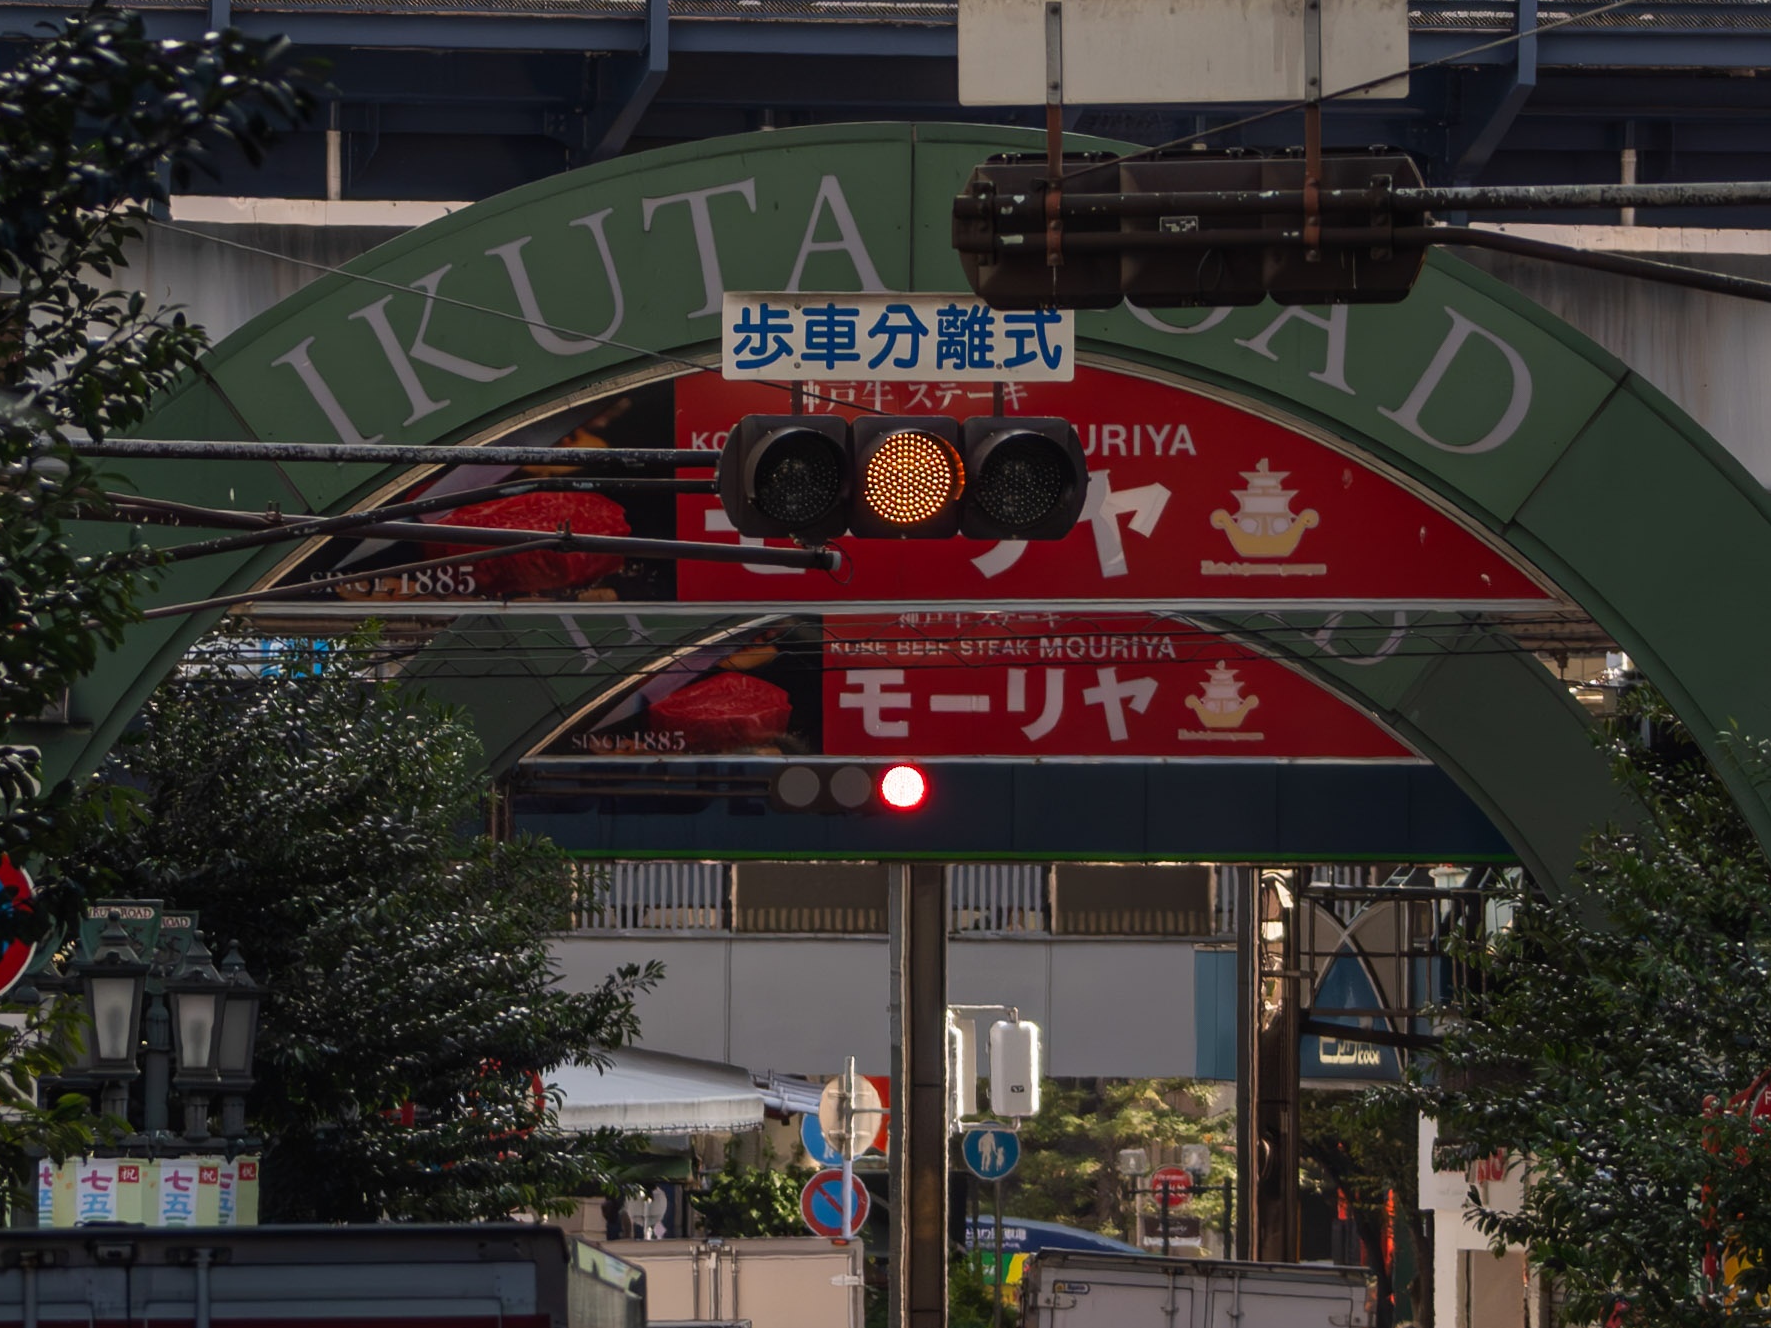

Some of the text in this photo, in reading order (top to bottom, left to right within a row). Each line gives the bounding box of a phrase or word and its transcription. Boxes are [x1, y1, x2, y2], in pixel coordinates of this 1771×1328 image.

[270, 173, 889, 449] IKUTA
[732, 303, 1063, 372] 歩車分離式
[909, 383, 1032, 413] ステーキ
[398, 565, 477, 595] 1885
[839, 668, 1159, 742] モーリヤ
[633, 730, 686, 751] 1885
